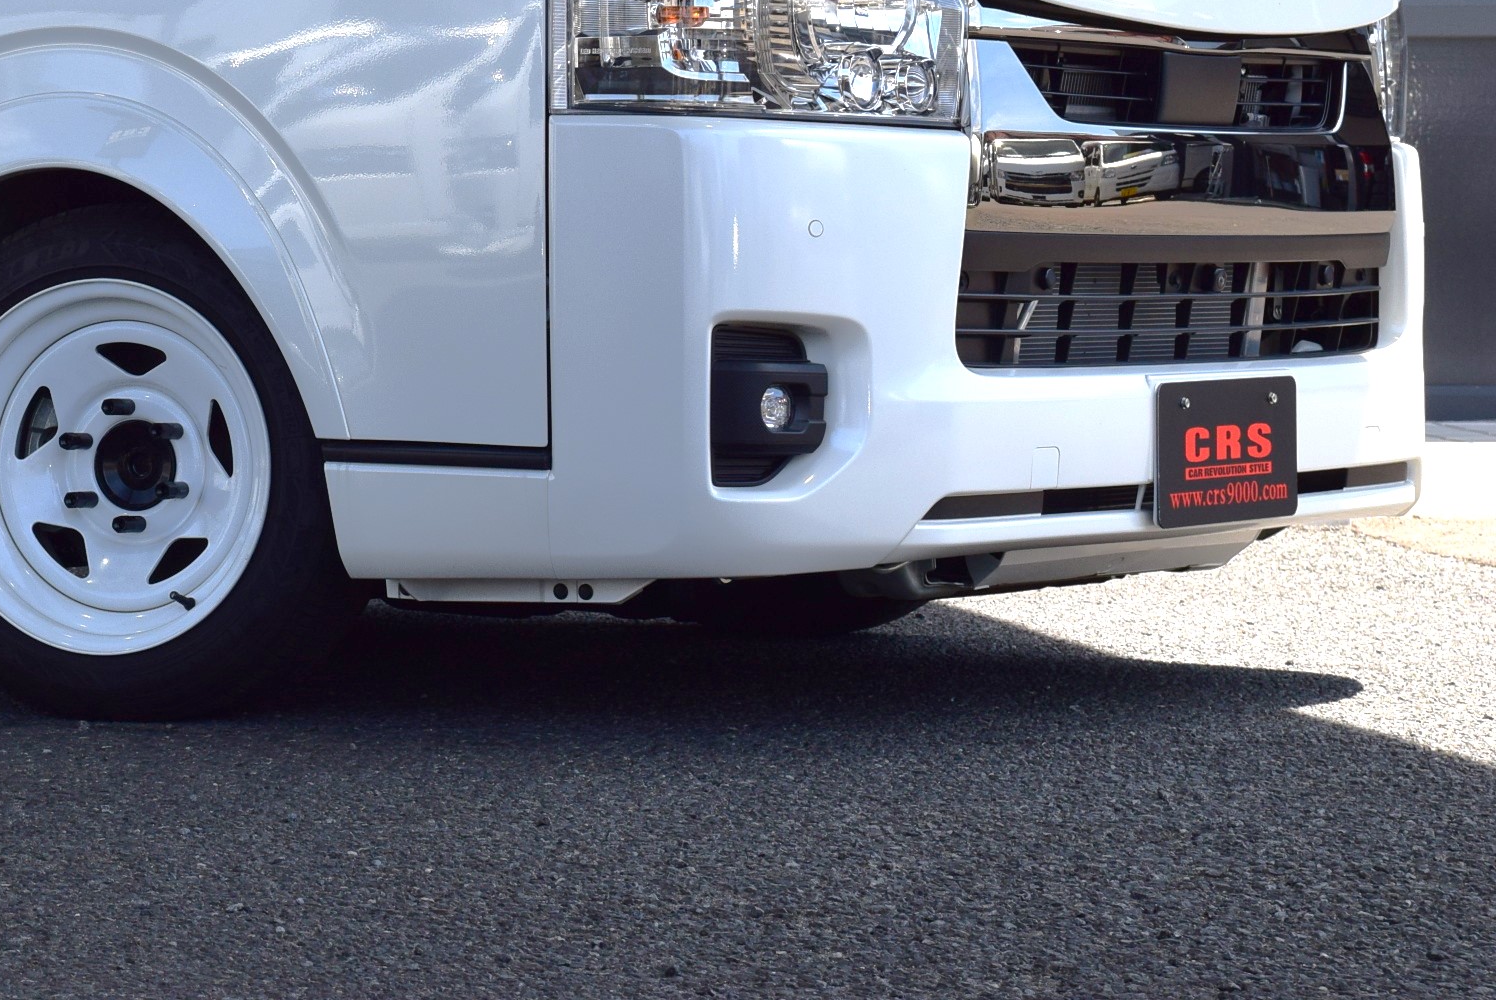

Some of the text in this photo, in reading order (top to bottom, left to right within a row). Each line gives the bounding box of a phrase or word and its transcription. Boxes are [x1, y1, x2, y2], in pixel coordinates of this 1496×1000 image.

[1185, 423, 1272, 462] CRS
[1188, 463, 1269, 479] CAR REVOLUTION STYLE
[1170, 481, 1287, 509] www.crs9000.com
